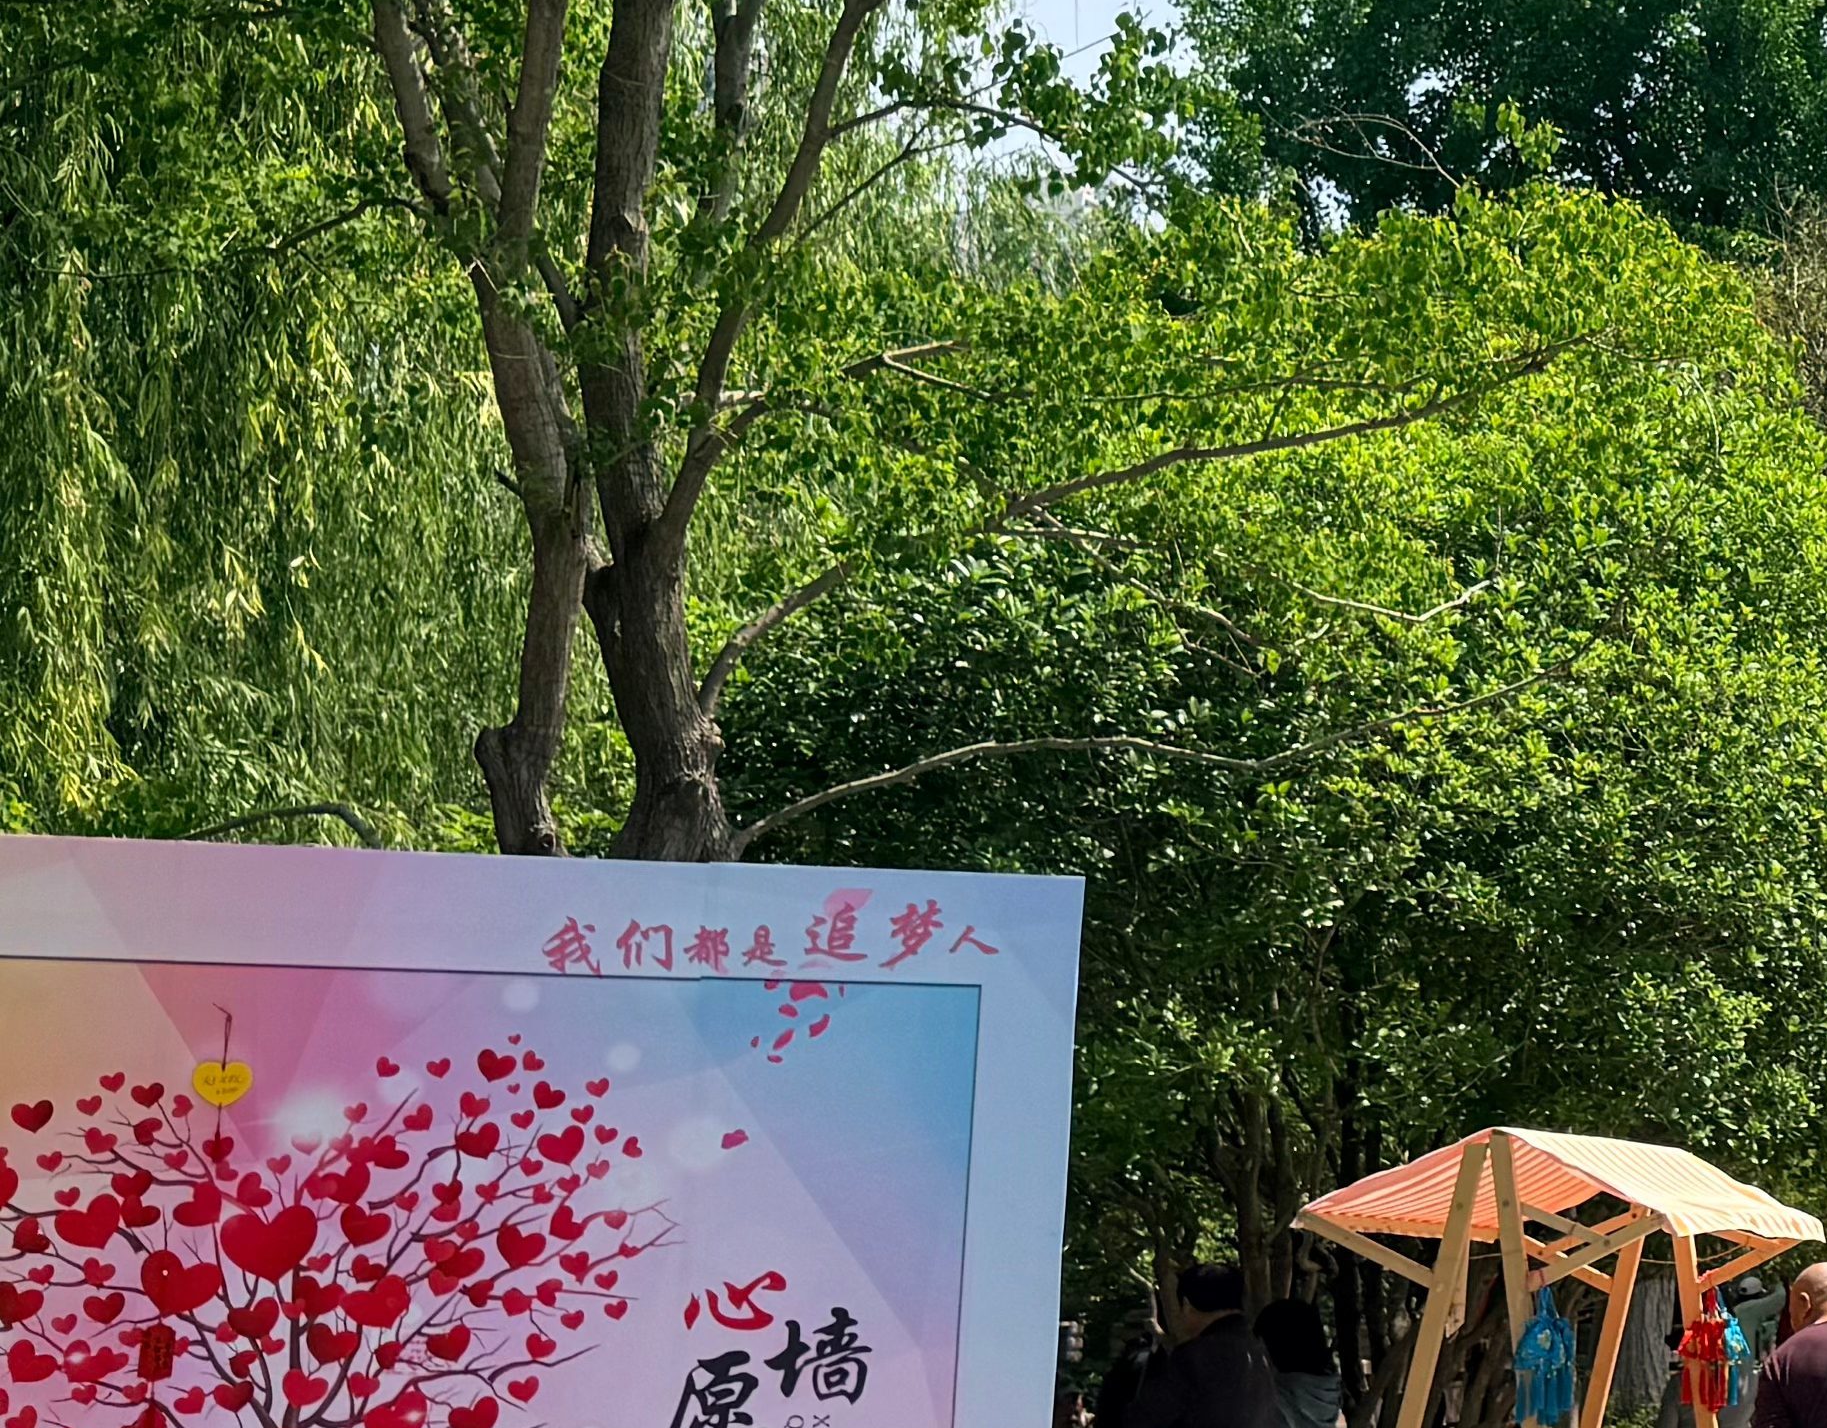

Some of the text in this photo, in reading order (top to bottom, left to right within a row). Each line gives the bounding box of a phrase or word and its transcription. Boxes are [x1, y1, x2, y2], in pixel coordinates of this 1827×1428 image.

[541, 899, 1000, 978] 我们都是追梦人
